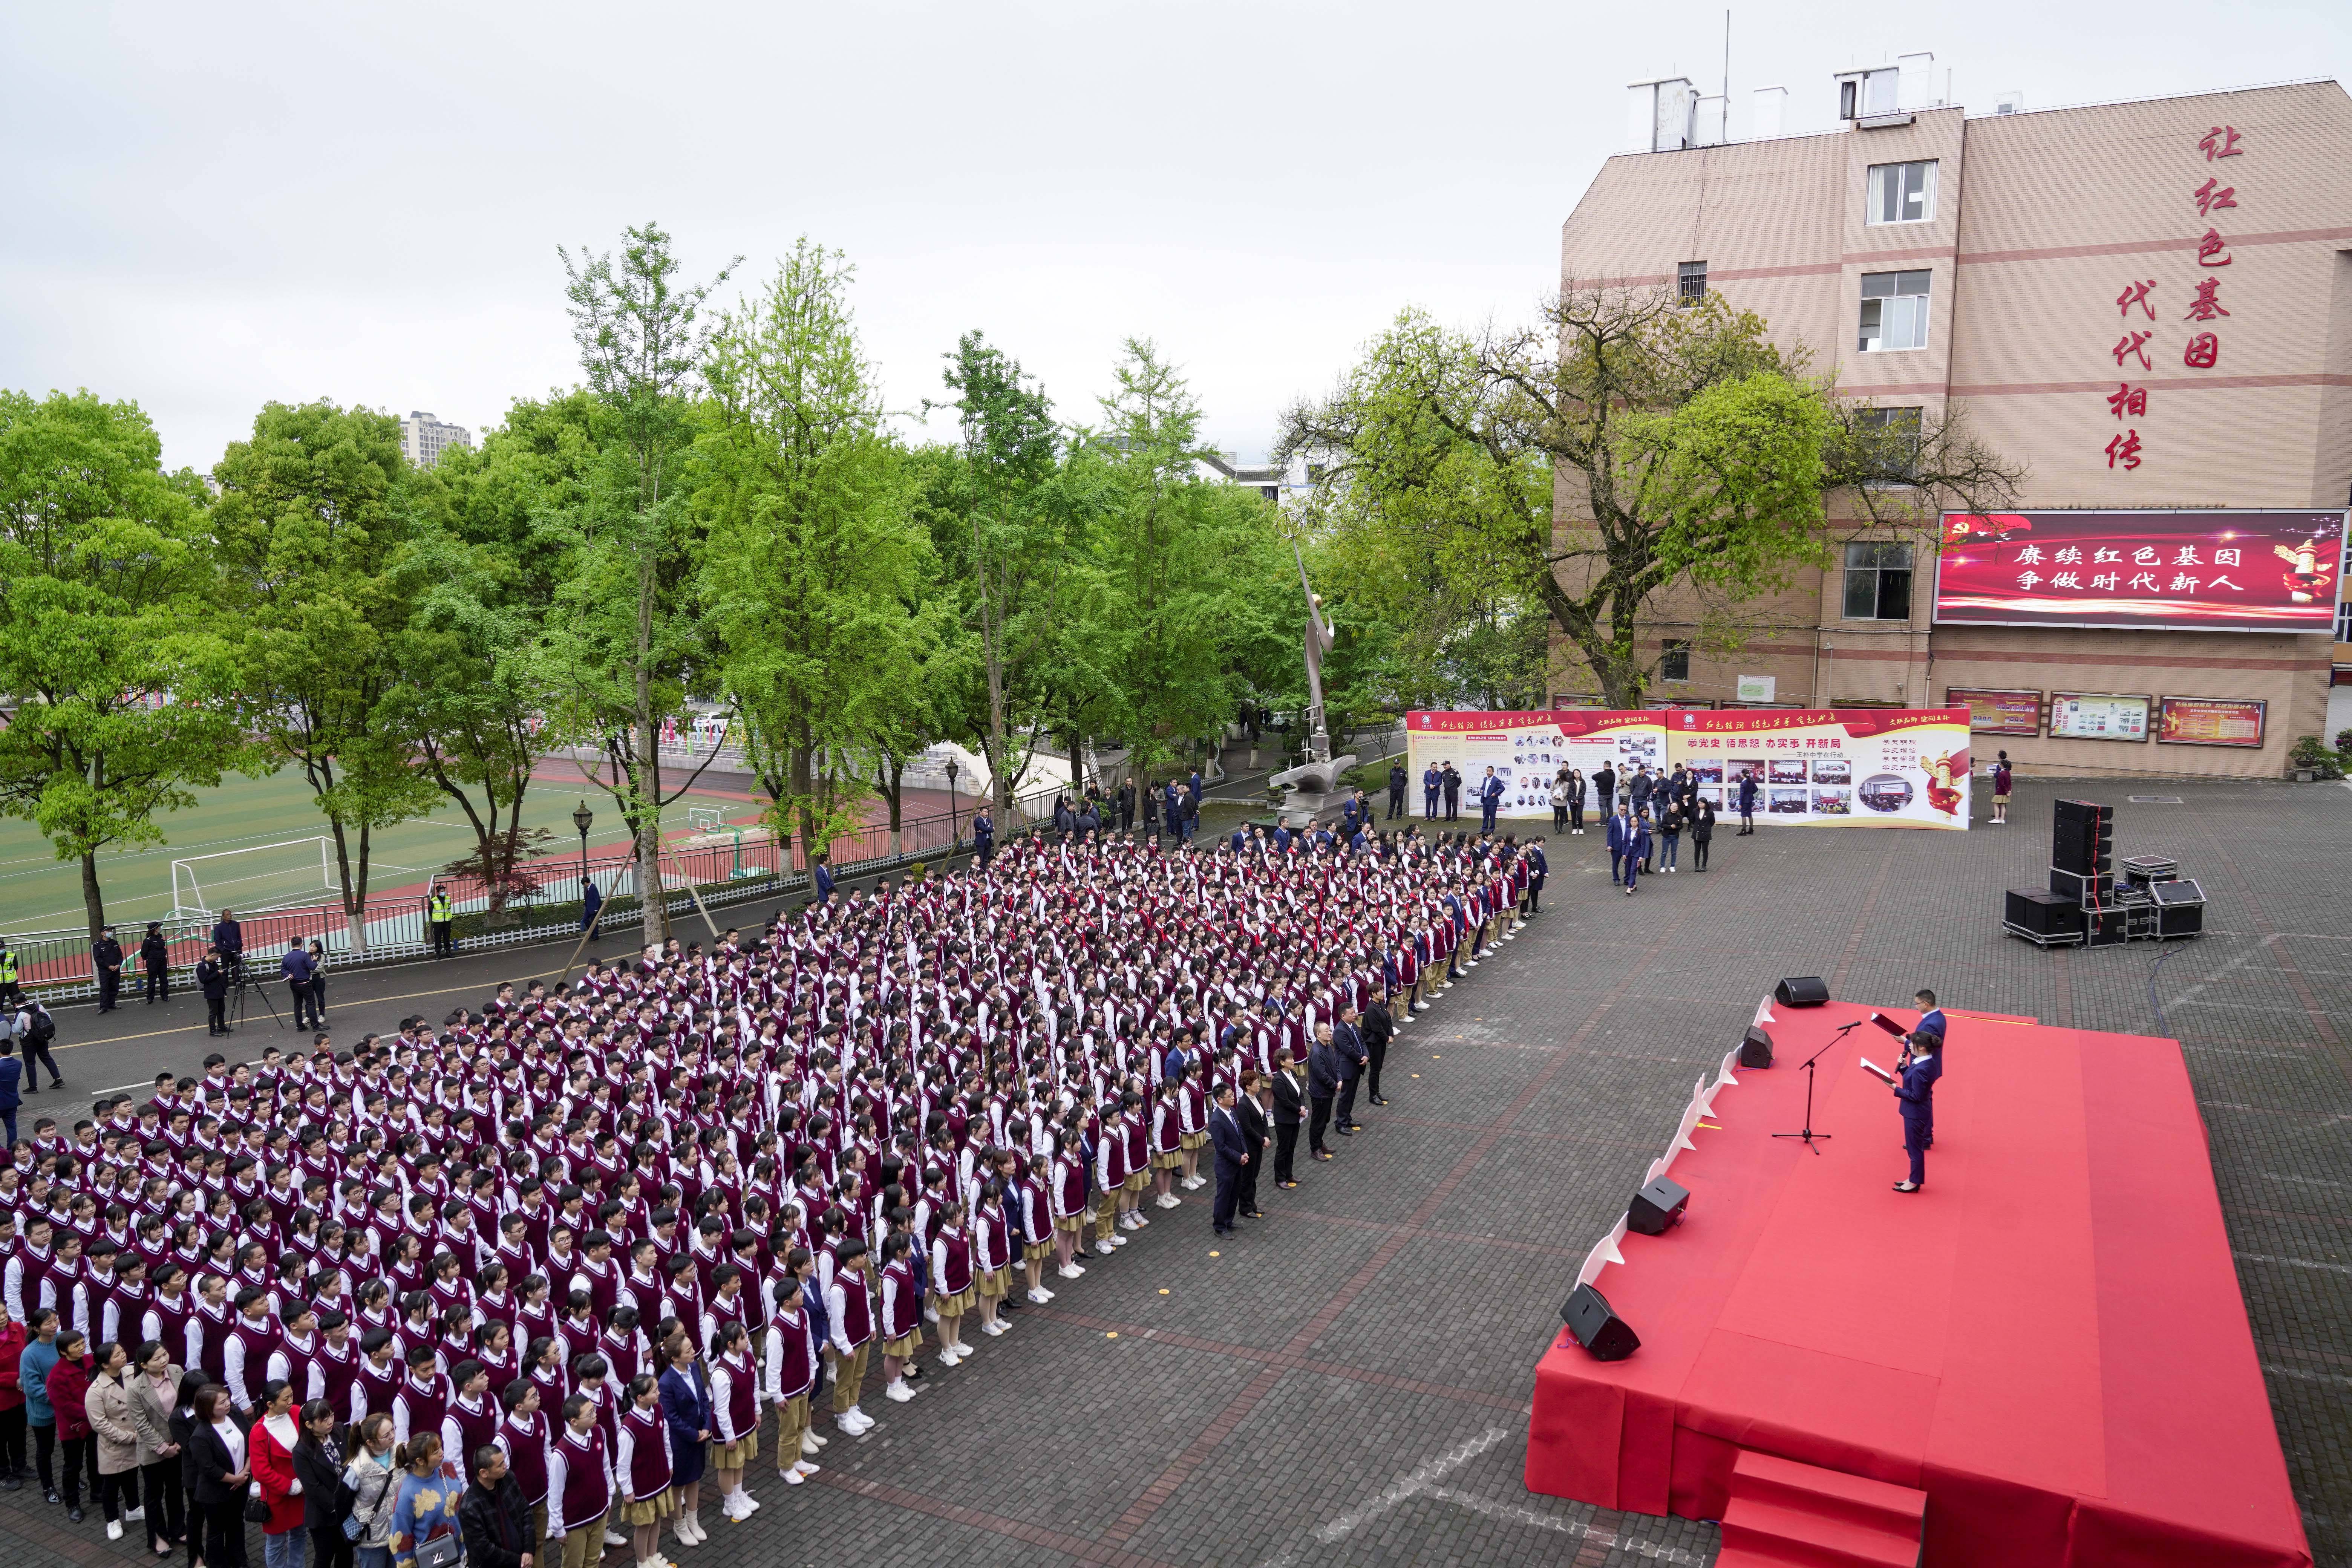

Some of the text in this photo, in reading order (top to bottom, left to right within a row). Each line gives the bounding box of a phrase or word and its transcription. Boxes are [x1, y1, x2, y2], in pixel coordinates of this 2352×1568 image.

[2184, 125, 2243, 368] 让红色基因
[2105, 280, 2156, 470] 代代相传
[2014, 544, 2241, 567] 赓续红色基因
[2016, 570, 2244, 594] 争做时代新人
[2055, 700, 2063, 725] 杰出校友
[1688, 738, 1841, 748] 学党史 悟思想 办实事 开新局
